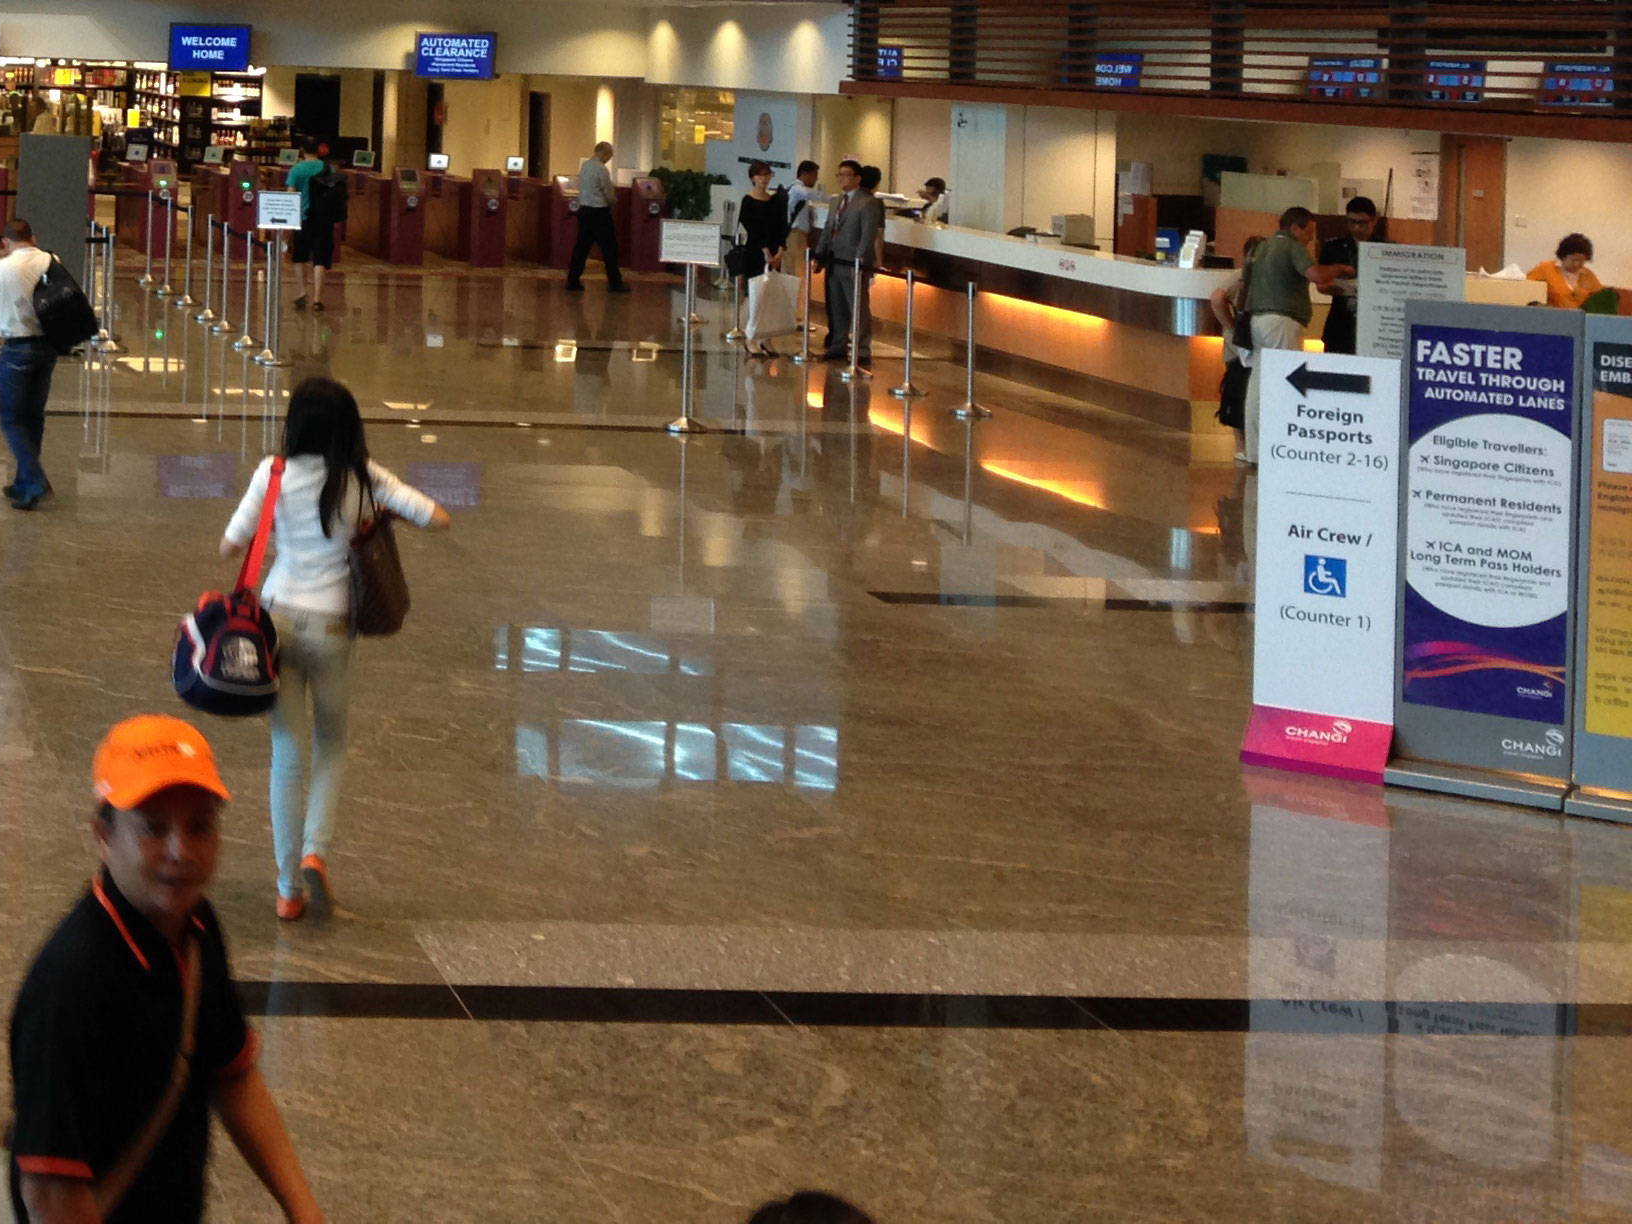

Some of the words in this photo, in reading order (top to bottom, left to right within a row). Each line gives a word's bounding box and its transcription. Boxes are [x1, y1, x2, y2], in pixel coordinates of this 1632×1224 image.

[181, 36, 237, 47] WELCOME
[421, 38, 490, 48] AUTOMATED
[192, 49, 225, 59] HOME
[421, 47, 488, 58] CLEARANCE
[1381, 249, 1445, 260] IMMIGRATION
[1417, 339, 1523, 370] FASTER
[1416, 367, 1476, 385] TRAVEL
[1479, 373, 1565, 393] THROUGH
[1424, 387, 1514, 406] AUTOMATED
[1518, 395, 1566, 411] LANES
[1296, 404, 1364, 426] Foreign
[1287, 423, 1373, 445] Passports
[1433, 435, 1479, 449] Eligible
[1482, 439, 1548, 456] Travellers:
[1271, 444, 1342, 465] (Counter
[1346, 452, 1389, 471] 2-16)
[1433, 456, 1500, 472] Singapore
[1504, 462, 1555, 477] Citizens
[1425, 490, 1497, 507] Permanent
[1500, 498, 1562, 515] Residents
[1288, 524, 1313, 539] Air
[1317, 528, 1361, 546] Crew
[1366, 533, 1373, 547] /
[1438, 541, 1463, 554] ICA
[1467, 546, 1493, 557] and
[1496, 549, 1533, 562] MOM
[1410, 550, 1442, 565] Long
[1445, 554, 1476, 567] Term
[1480, 558, 1509, 571] Pass
[1512, 563, 1562, 577] Holders
[1279, 604, 1352, 627] (Counter
[1357, 615, 1372, 632] 1)
[1516, 686, 1553, 697] CHANGI
[1285, 726, 1348, 744] CHANGI
[1501, 739, 1562, 757] CHANGI
